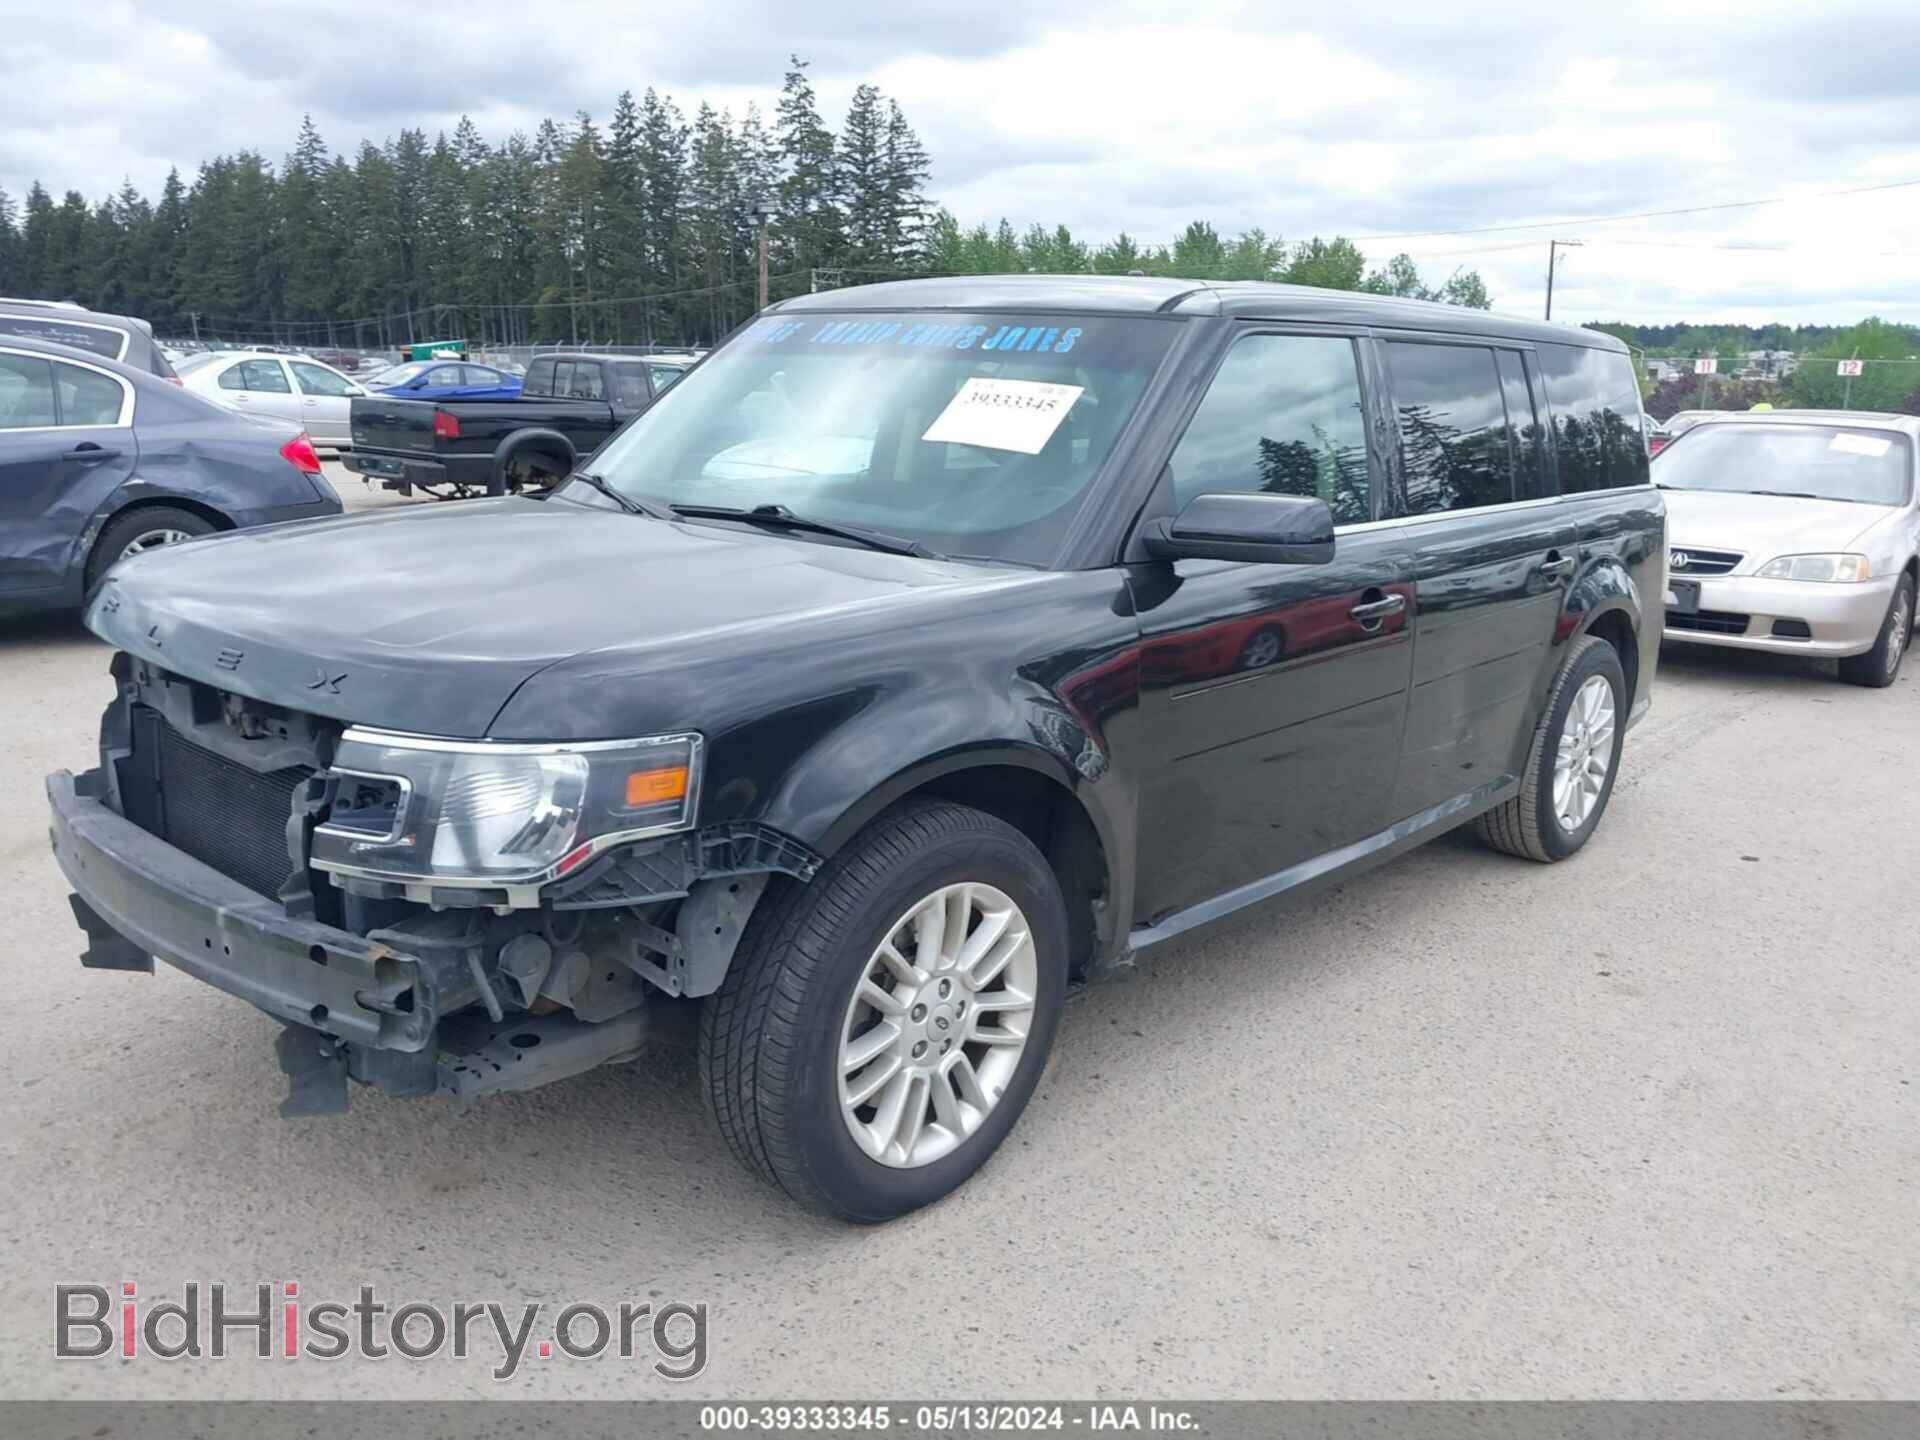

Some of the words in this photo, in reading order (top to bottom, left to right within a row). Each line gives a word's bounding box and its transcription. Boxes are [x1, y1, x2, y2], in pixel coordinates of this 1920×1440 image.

[981, 326, 1082, 353] JONES
[1700, 360, 1712, 372] 11
[1841, 362, 1856, 374] 12
